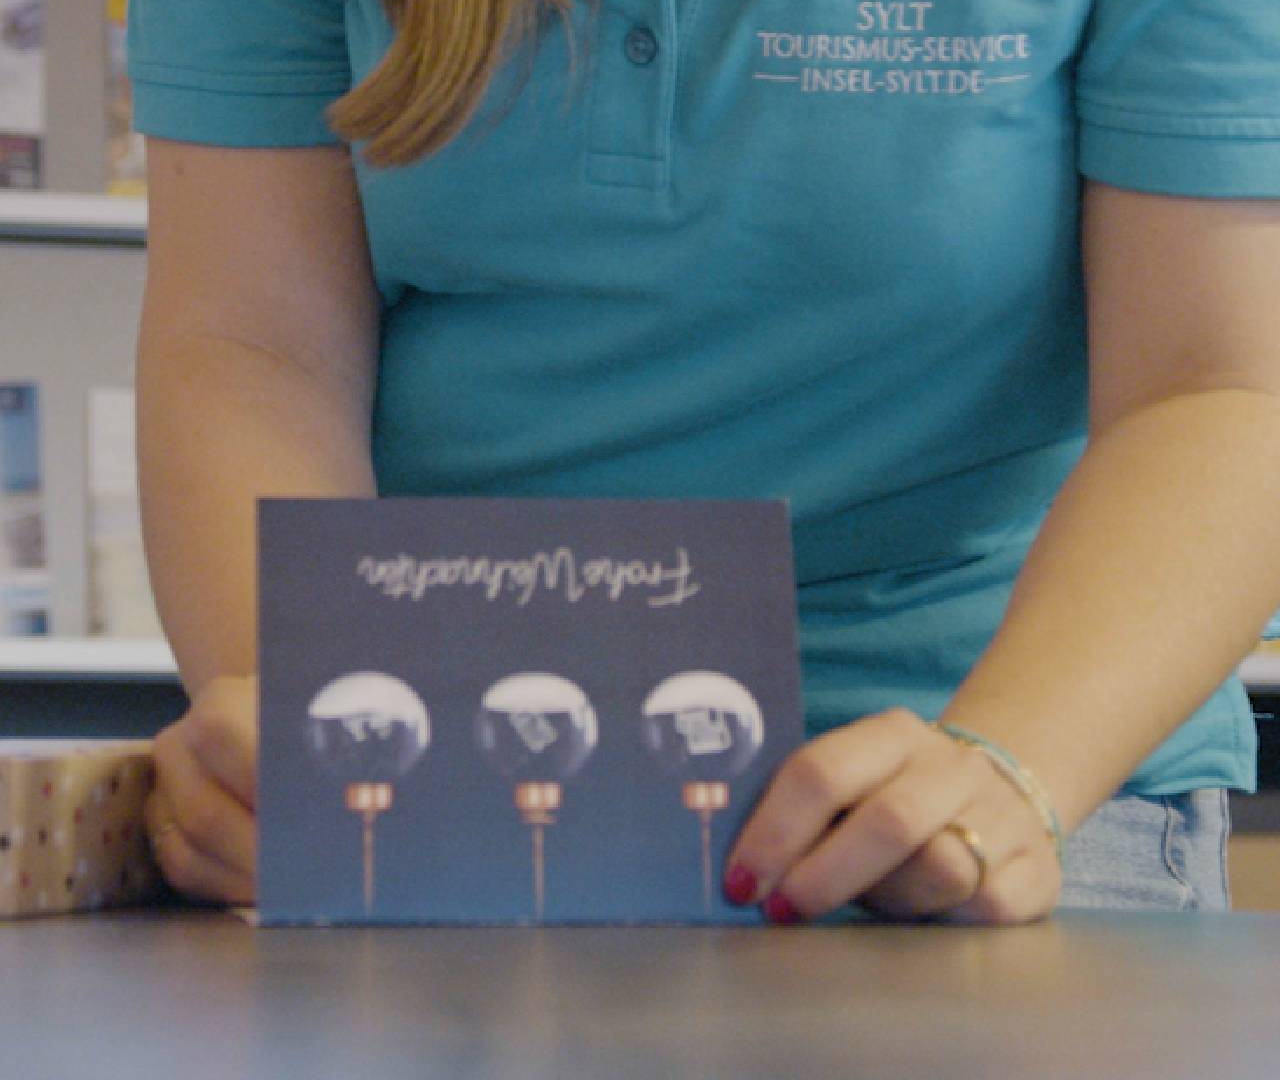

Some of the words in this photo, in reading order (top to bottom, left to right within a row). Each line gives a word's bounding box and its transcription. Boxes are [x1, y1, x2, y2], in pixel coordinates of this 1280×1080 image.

[856, 1, 934, 31] SYLT
[756, 31, 1032, 62] TOURISMUS-SERVICE
[357, 546, 587, 606] Weihnachten
[584, 547, 702, 608] Frohe
